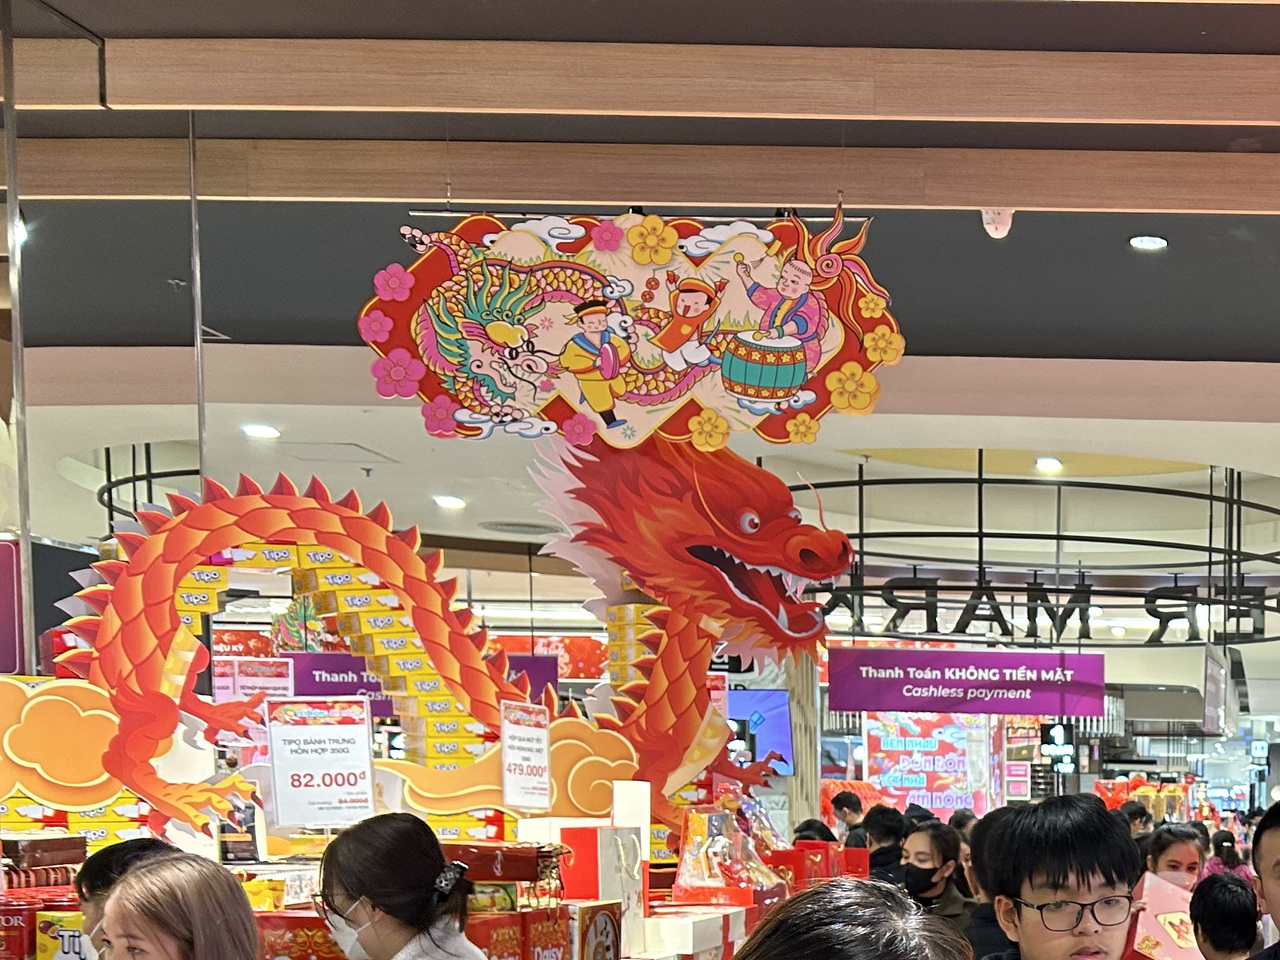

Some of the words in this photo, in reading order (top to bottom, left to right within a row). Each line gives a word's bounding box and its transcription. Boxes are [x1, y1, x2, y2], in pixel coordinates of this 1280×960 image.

[262, 549, 289, 562] Tipo
[306, 550, 333, 563] Tipo
[191, 569, 220, 583] Tipo
[324, 572, 351, 585] Tipo
[180, 592, 209, 605] Tipo
[344, 594, 371, 607] Tipo
[367, 615, 394, 629] Tipo
[380, 637, 407, 650] Tipo
[396, 658, 422, 671] Tipo
[312, 670, 357, 683] Thanh
[859, 666, 904, 679] Thanh
[907, 667, 941, 679] Toán
[944, 666, 1000, 681] KHÔNG
[1041, 667, 1074, 684] MẶT
[413, 679, 439, 692] Tipo
[903, 685, 963, 698] Cashless
[966, 687, 1031, 700] payment
[425, 700, 450, 711] Tipo
[433, 721, 458, 733] Tipo
[433, 742, 458, 754] Tipo
[290, 771, 366, 788] 82.000đ
[78, 828, 108, 841] Tipo
[653, 828, 670, 840] Tip
